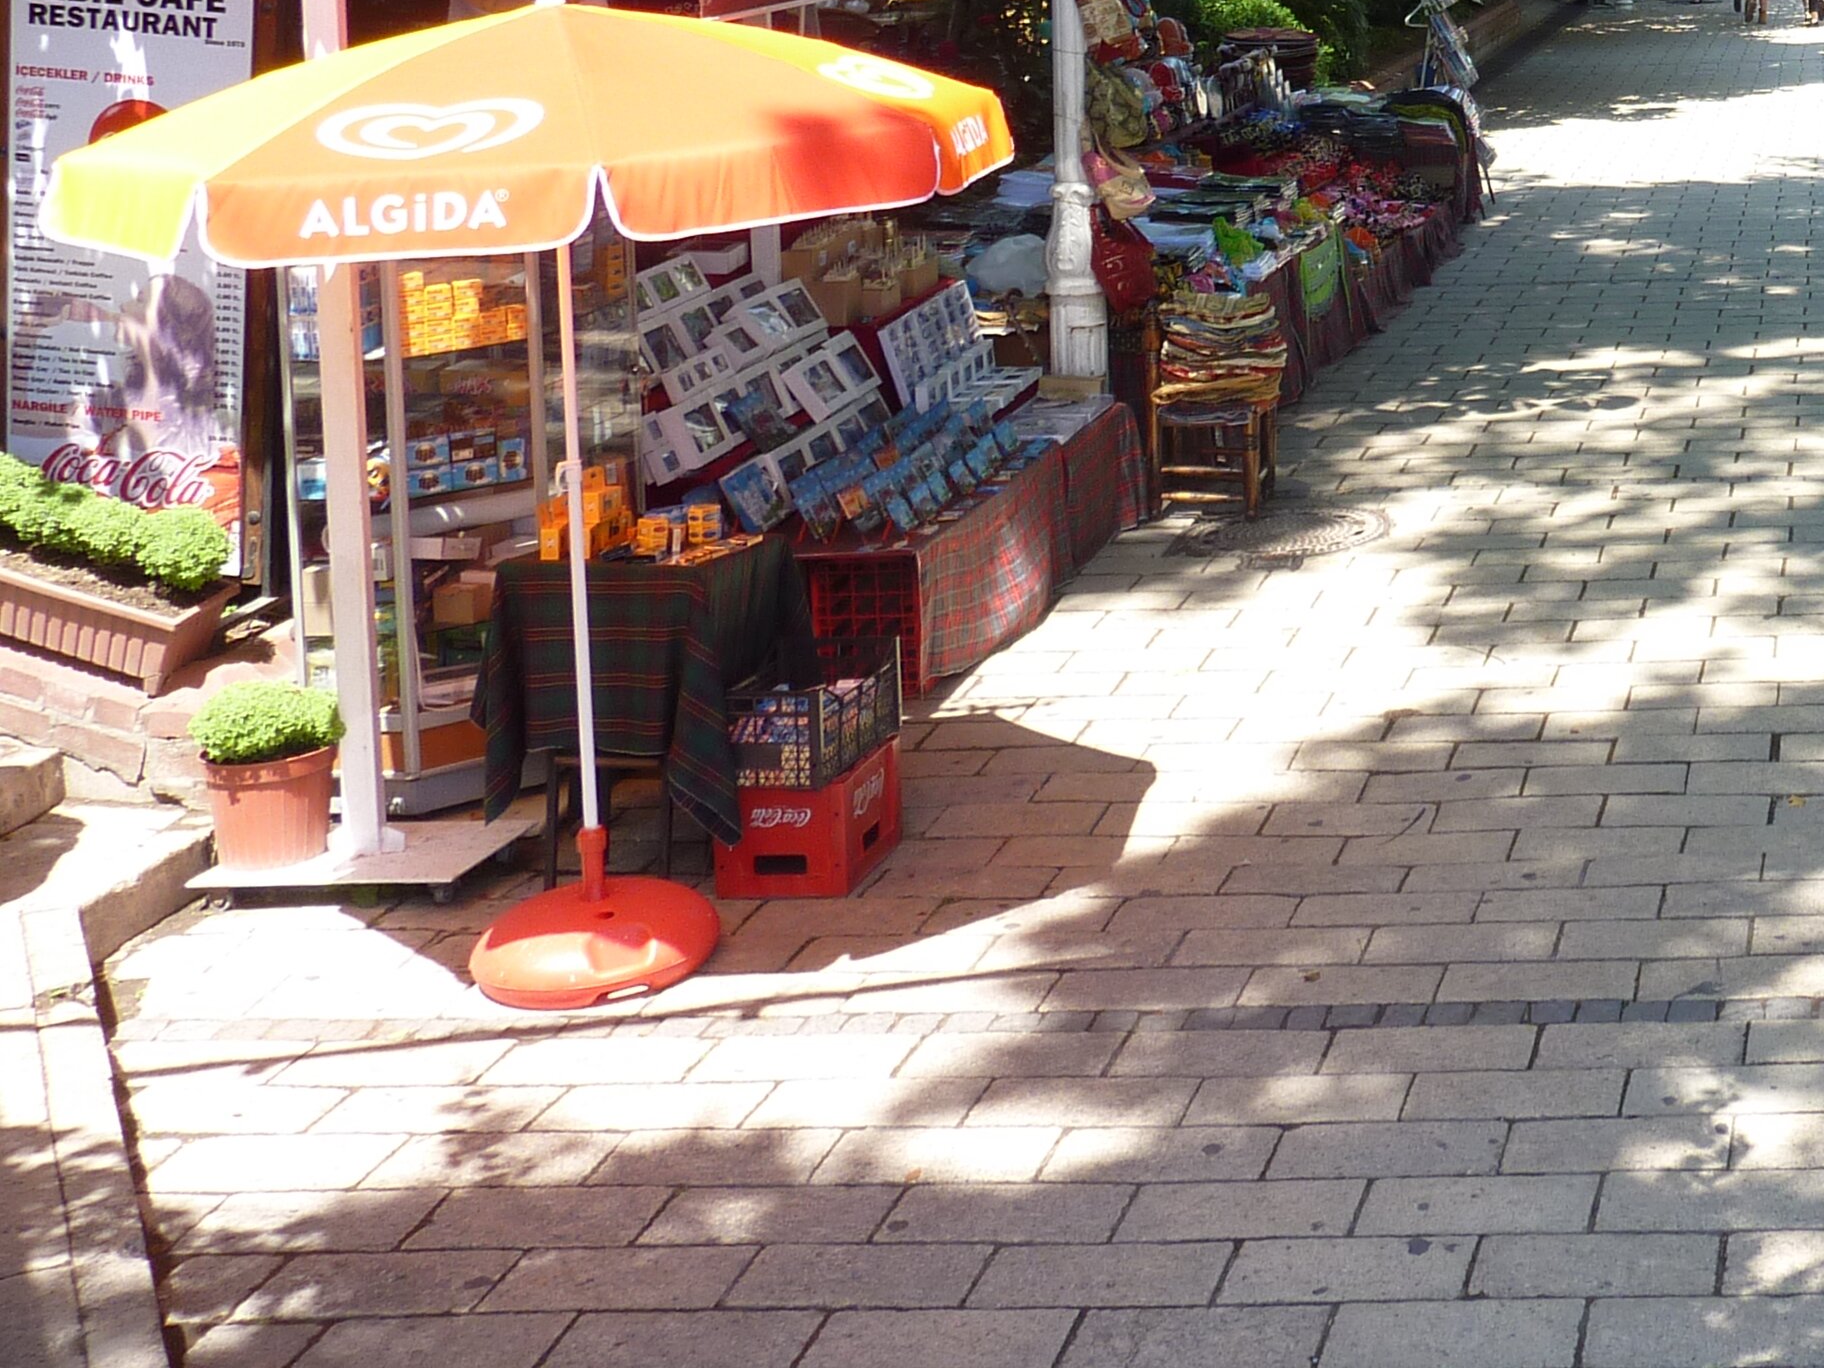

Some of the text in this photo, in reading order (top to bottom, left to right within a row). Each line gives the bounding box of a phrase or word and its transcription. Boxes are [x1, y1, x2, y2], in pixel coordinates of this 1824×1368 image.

[28, 3, 218, 39] RESTAURANT
[85, 404, 128, 421] WATER
[132, 409, 164, 423] PIPE
